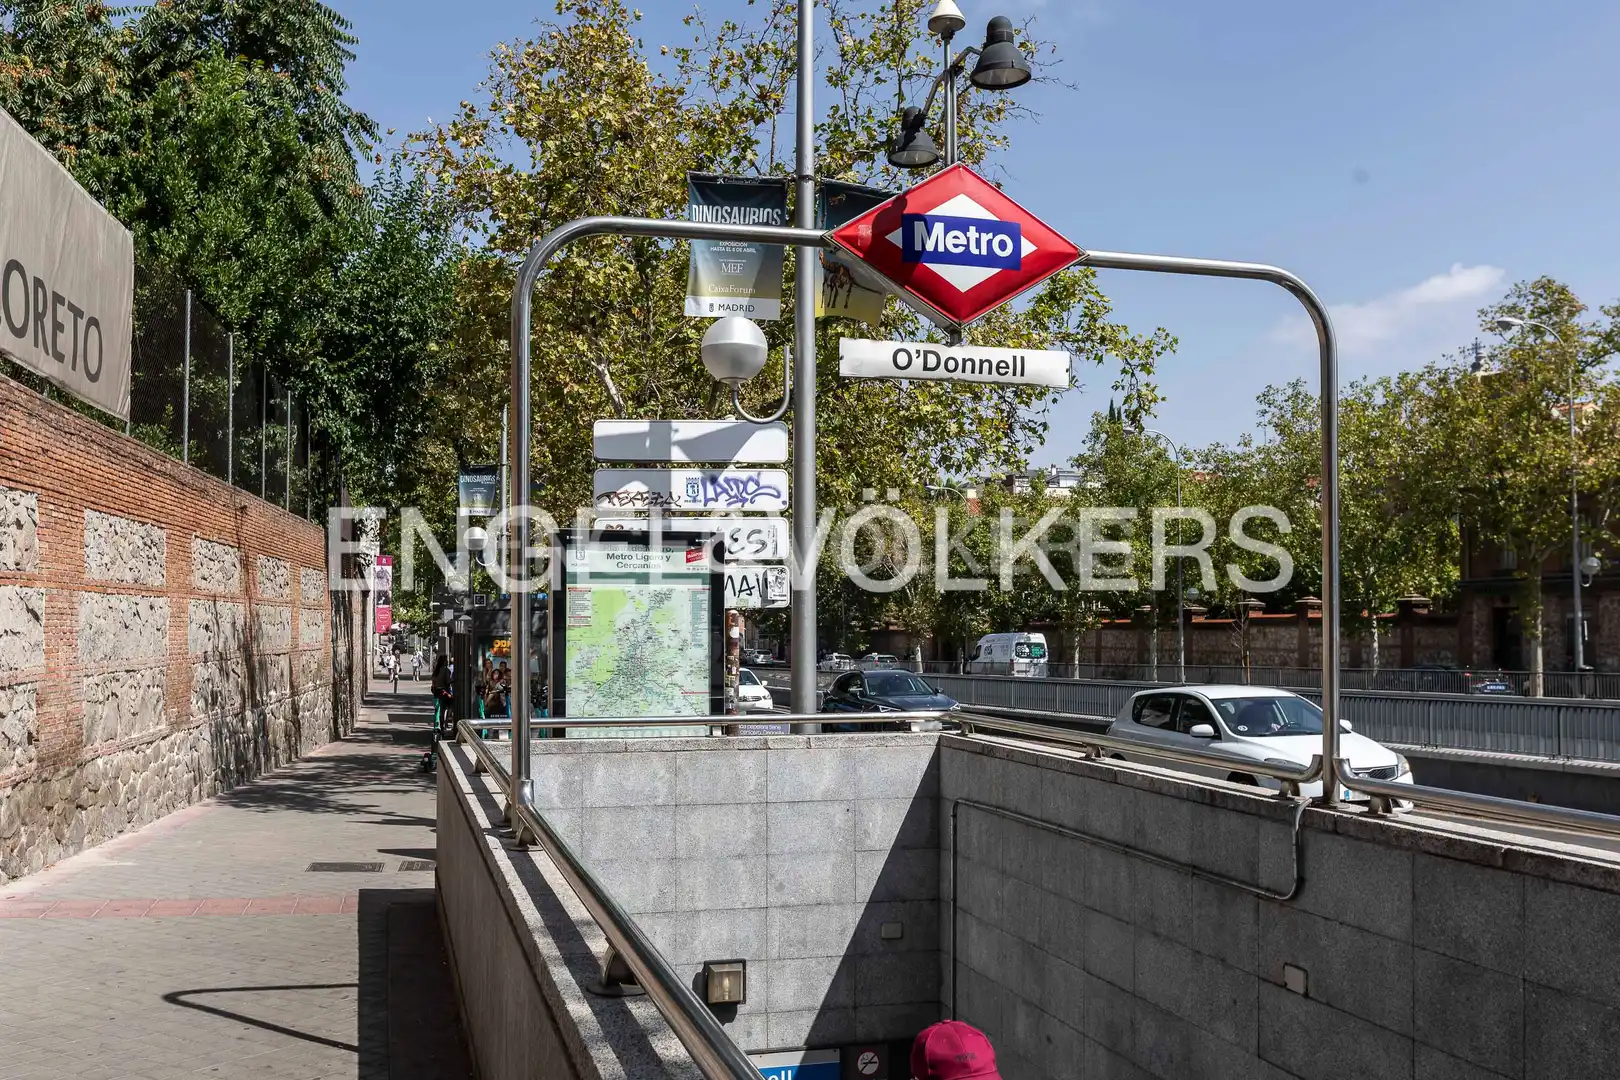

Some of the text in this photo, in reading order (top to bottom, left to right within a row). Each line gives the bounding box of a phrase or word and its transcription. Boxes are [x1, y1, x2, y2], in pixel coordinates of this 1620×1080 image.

[691, 204, 782, 226] DINOSAURIOS
[914, 220, 1014, 258] Metro
[721, 262, 744, 273] MEF
[708, 284, 756, 295] CaixaForum
[718, 303, 755, 313] MADRID
[0, 258, 103, 384] ORETO
[892, 347, 1026, 378] O'Donnell
[606, 552, 633, 561] Metro
[665, 555, 672, 563] y
